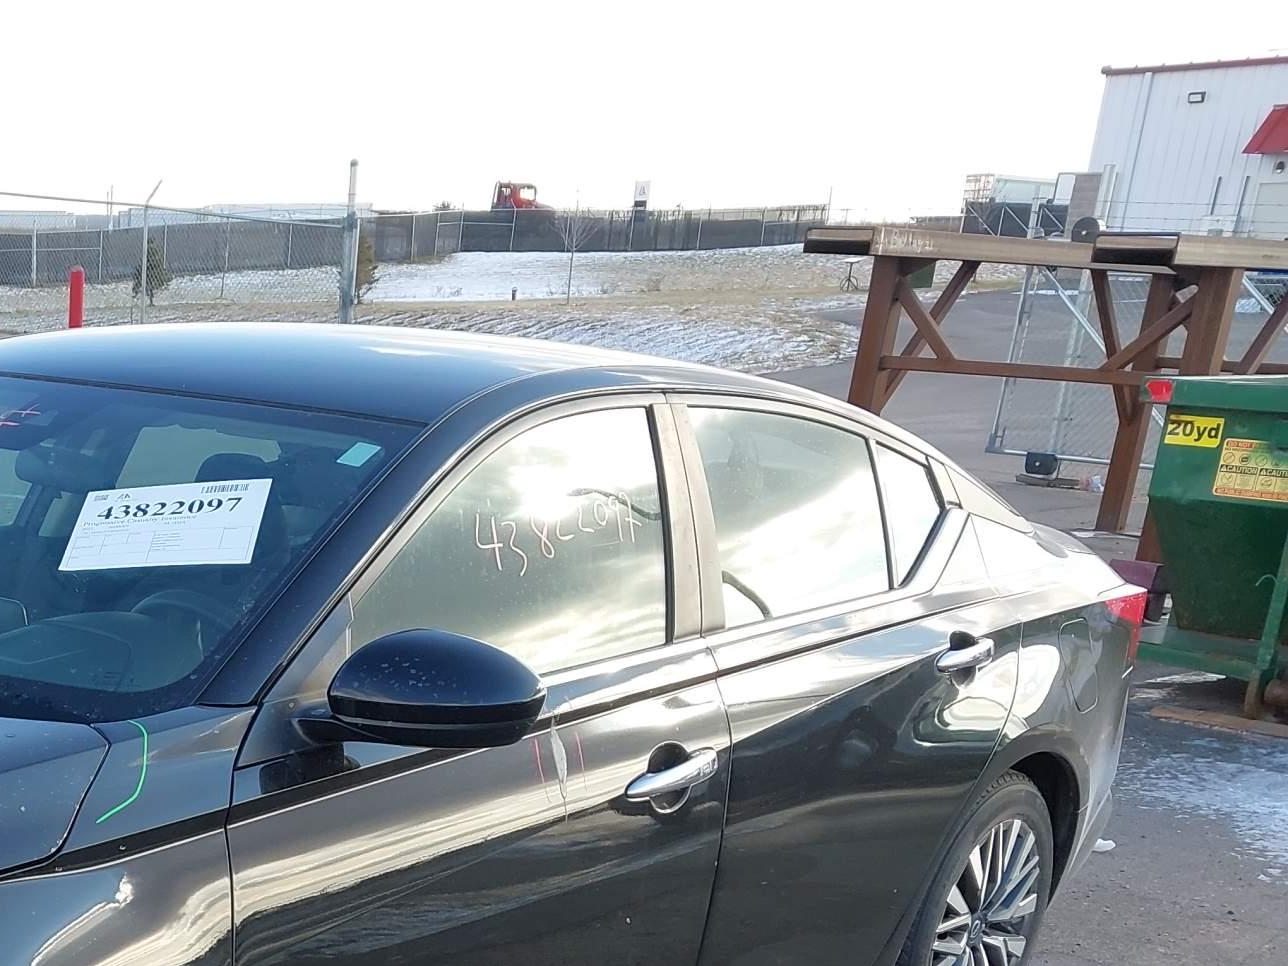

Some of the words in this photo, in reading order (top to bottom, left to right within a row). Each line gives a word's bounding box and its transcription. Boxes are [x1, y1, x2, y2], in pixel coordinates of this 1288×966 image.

[1167, 420, 1222, 442] 20yd
[1227, 465, 1257, 474] CAUTION
[97, 497, 243, 520] 43822097
